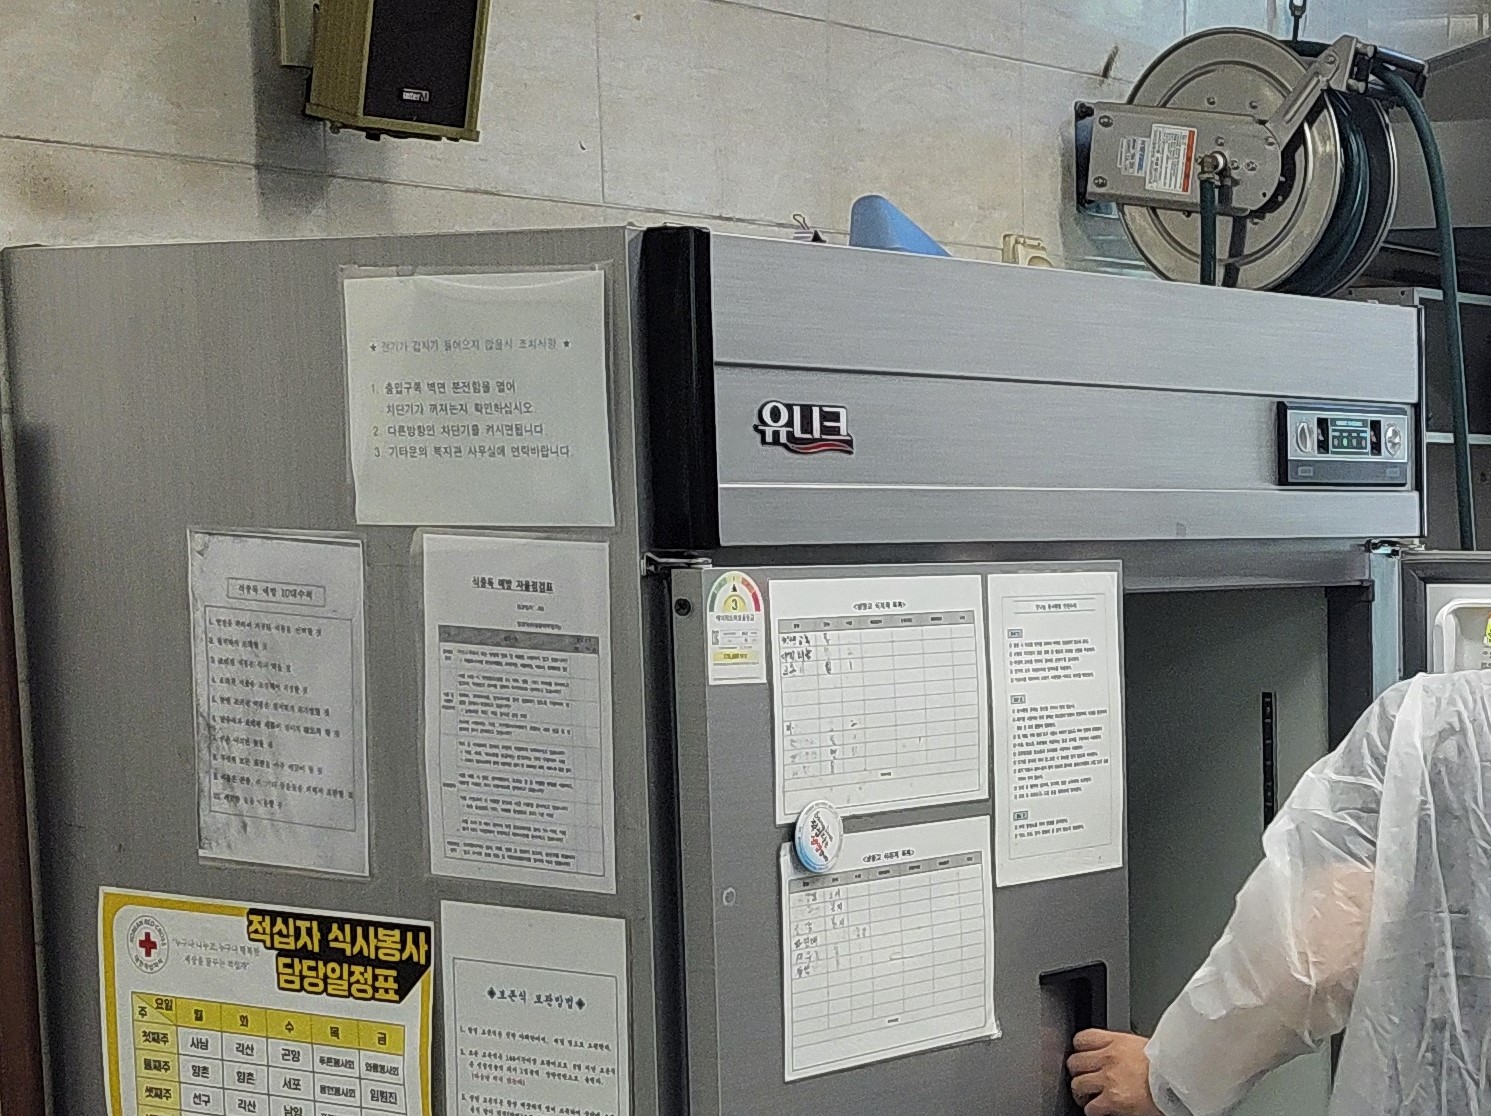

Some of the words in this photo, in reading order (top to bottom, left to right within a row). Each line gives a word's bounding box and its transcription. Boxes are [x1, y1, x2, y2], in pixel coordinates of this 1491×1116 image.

[757, 401, 851, 443] 유니크
[247, 914, 321, 951] 적십자
[327, 924, 428, 965] 식사봉사
[276, 956, 400, 1001] 담당일정표
[497, 989, 527, 1004] 보존식
[155, 998, 173, 1011] 요일
[138, 1006, 148, 1019] 주
[194, 1009, 203, 1022] 월
[239, 1014, 249, 1027] 화
[285, 1021, 294, 1034] 수
[142, 1030, 169, 1045] 첫째주
[330, 1026, 340, 1039] 목
[377, 1032, 387, 1045] 금
[190, 1036, 208, 1050] 사남
[235, 1042, 254, 1056] 각산
[144, 1058, 171, 1073] 둘째주
[283, 1077, 301, 1091] 서포
[145, 1086, 172, 1101] 셋째주
[192, 1093, 210, 1106] 선구
[238, 1099, 256, 1113] 각산
